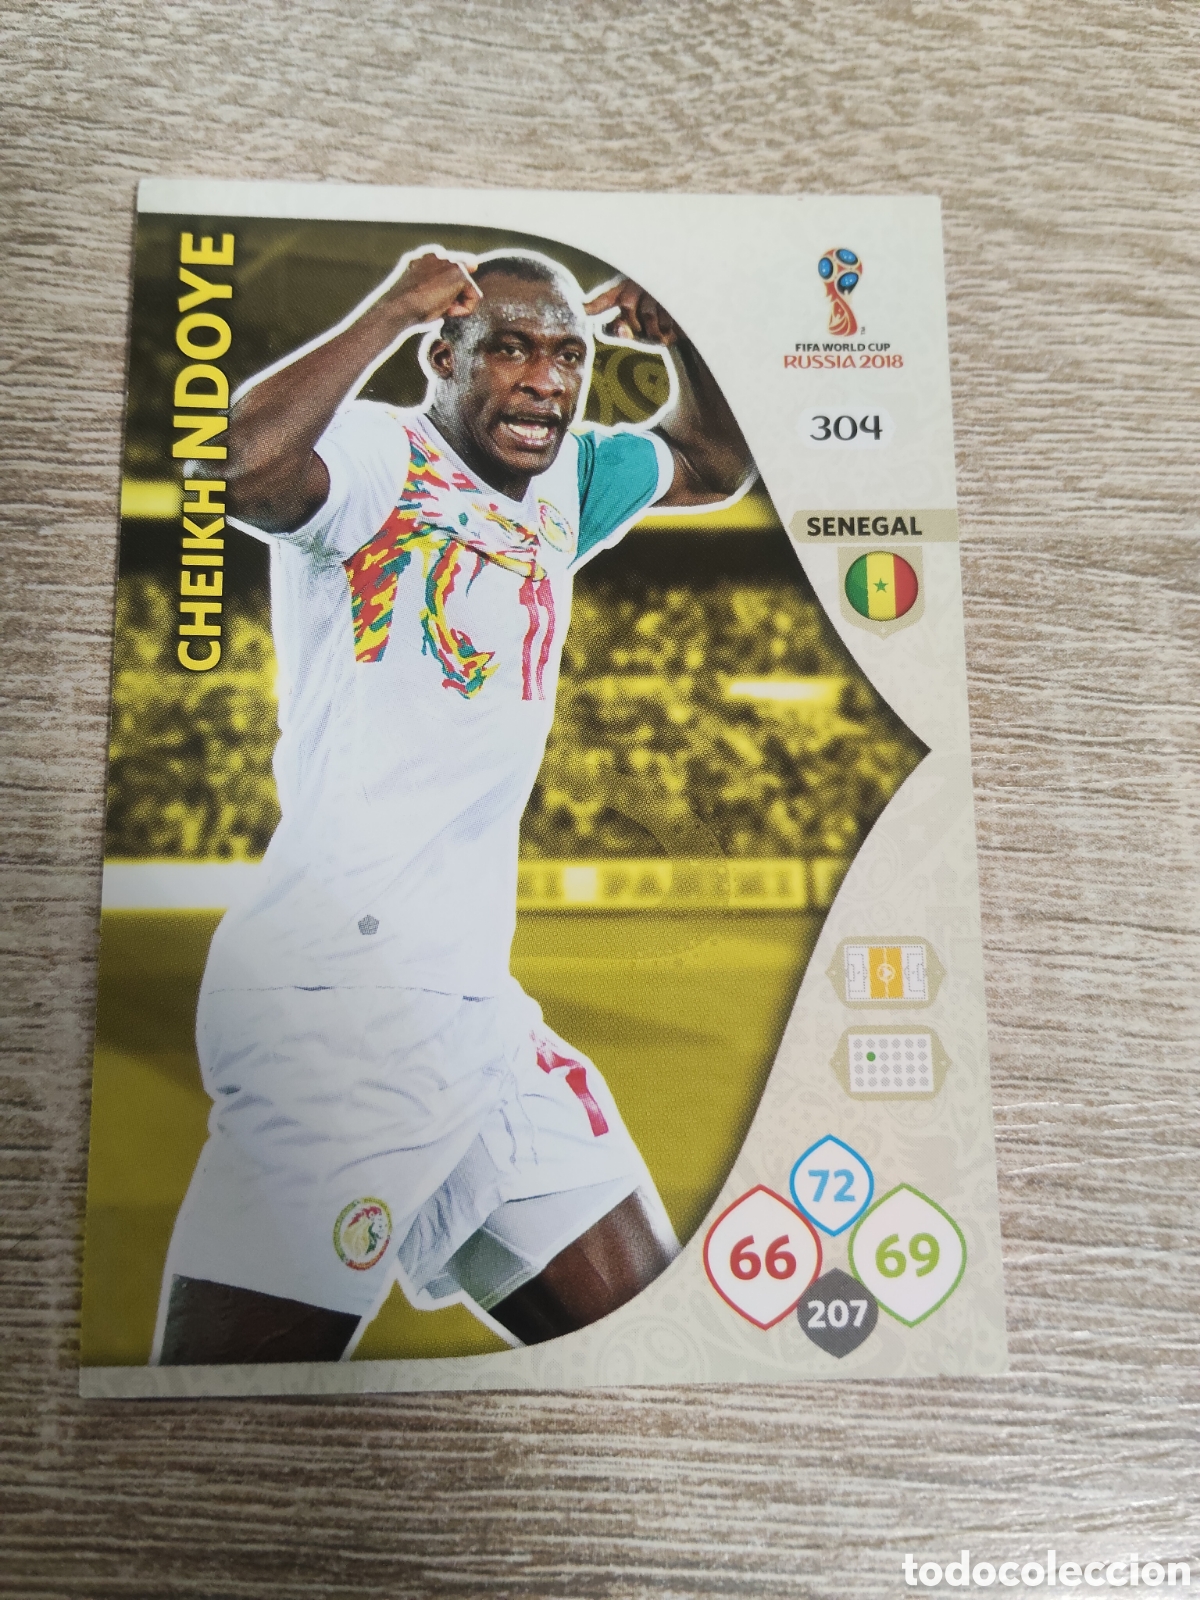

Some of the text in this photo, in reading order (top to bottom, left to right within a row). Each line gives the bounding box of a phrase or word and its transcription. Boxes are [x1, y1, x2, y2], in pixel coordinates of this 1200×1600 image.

[783, 354, 904, 369] RUSSIA 2018
[795, 343, 891, 352] FIFA WORLD CUP
[809, 415, 883, 441] 304
[172, 232, 235, 672] CHEIKH NDOYE
[807, 516, 923, 537] SENEGAL
[807, 1169, 856, 1202] 72
[729, 1234, 797, 1280] 66
[875, 1232, 940, 1279] 69
[807, 1299, 868, 1329] 207
